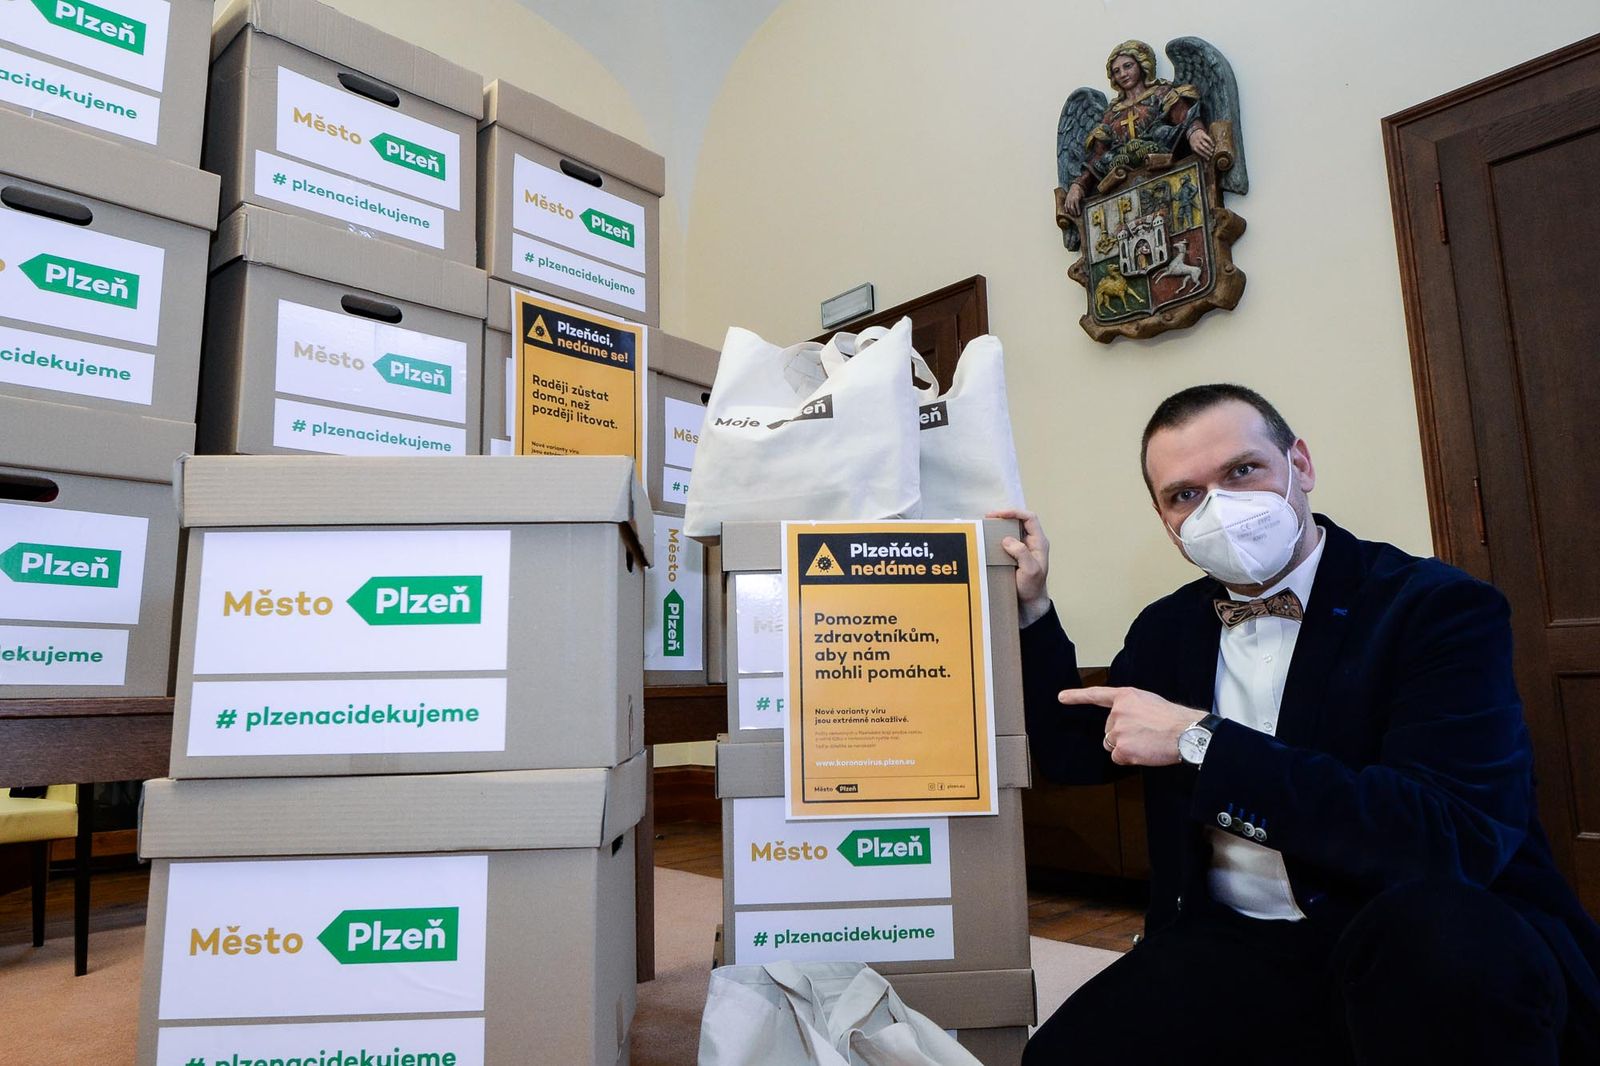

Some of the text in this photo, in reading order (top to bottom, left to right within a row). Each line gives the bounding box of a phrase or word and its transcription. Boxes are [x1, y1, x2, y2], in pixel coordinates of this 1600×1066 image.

[55, 1, 136, 45] Plzeň
[293, 107, 440, 173] Město Plzeň
[292, 178, 430, 229] plzenacidekujeme
[524, 189, 631, 241] Město Plzeň
[45, 263, 129, 299] Plzeň
[538, 256, 636, 295] plzenacidekujeme
[557, 320, 614, 347] Plzeňáci,
[294, 341, 446, 387] Město Plzeň
[557, 337, 629, 364] nedáme se!
[532, 374, 609, 402] Raději zůstat
[532, 389, 591, 412] doma, než
[532, 403, 619, 429] později litovat.
[714, 400, 827, 428] Moje eň
[312, 421, 452, 452] plzenacidekujeme
[850, 542, 934, 559] Plzeňáci,
[21, 552, 110, 579] Plzeň
[851, 560, 958, 576] nedáme se!
[223, 585, 470, 617] Město Plzeň
[668, 528, 680, 650] Město Plzeň
[814, 612, 898, 625] Pomozme
[814, 627, 940, 645] zdravotníkům,
[0, 646, 103, 665] ekujeme
[815, 648, 890, 665] aby nám
[815, 665, 951, 682] mohli pomáhat.
[246, 703, 479, 732] plzenacidekujeme
[814, 717, 831, 725] jsou
[836, 707, 869, 716] varianty
[815, 758, 915, 767] www.koronavirus.plzen.eu
[751, 835, 923, 862] Město Plzeň
[189, 918, 445, 956] Město Plzeň
[774, 925, 935, 948] plzenacidekujeme
